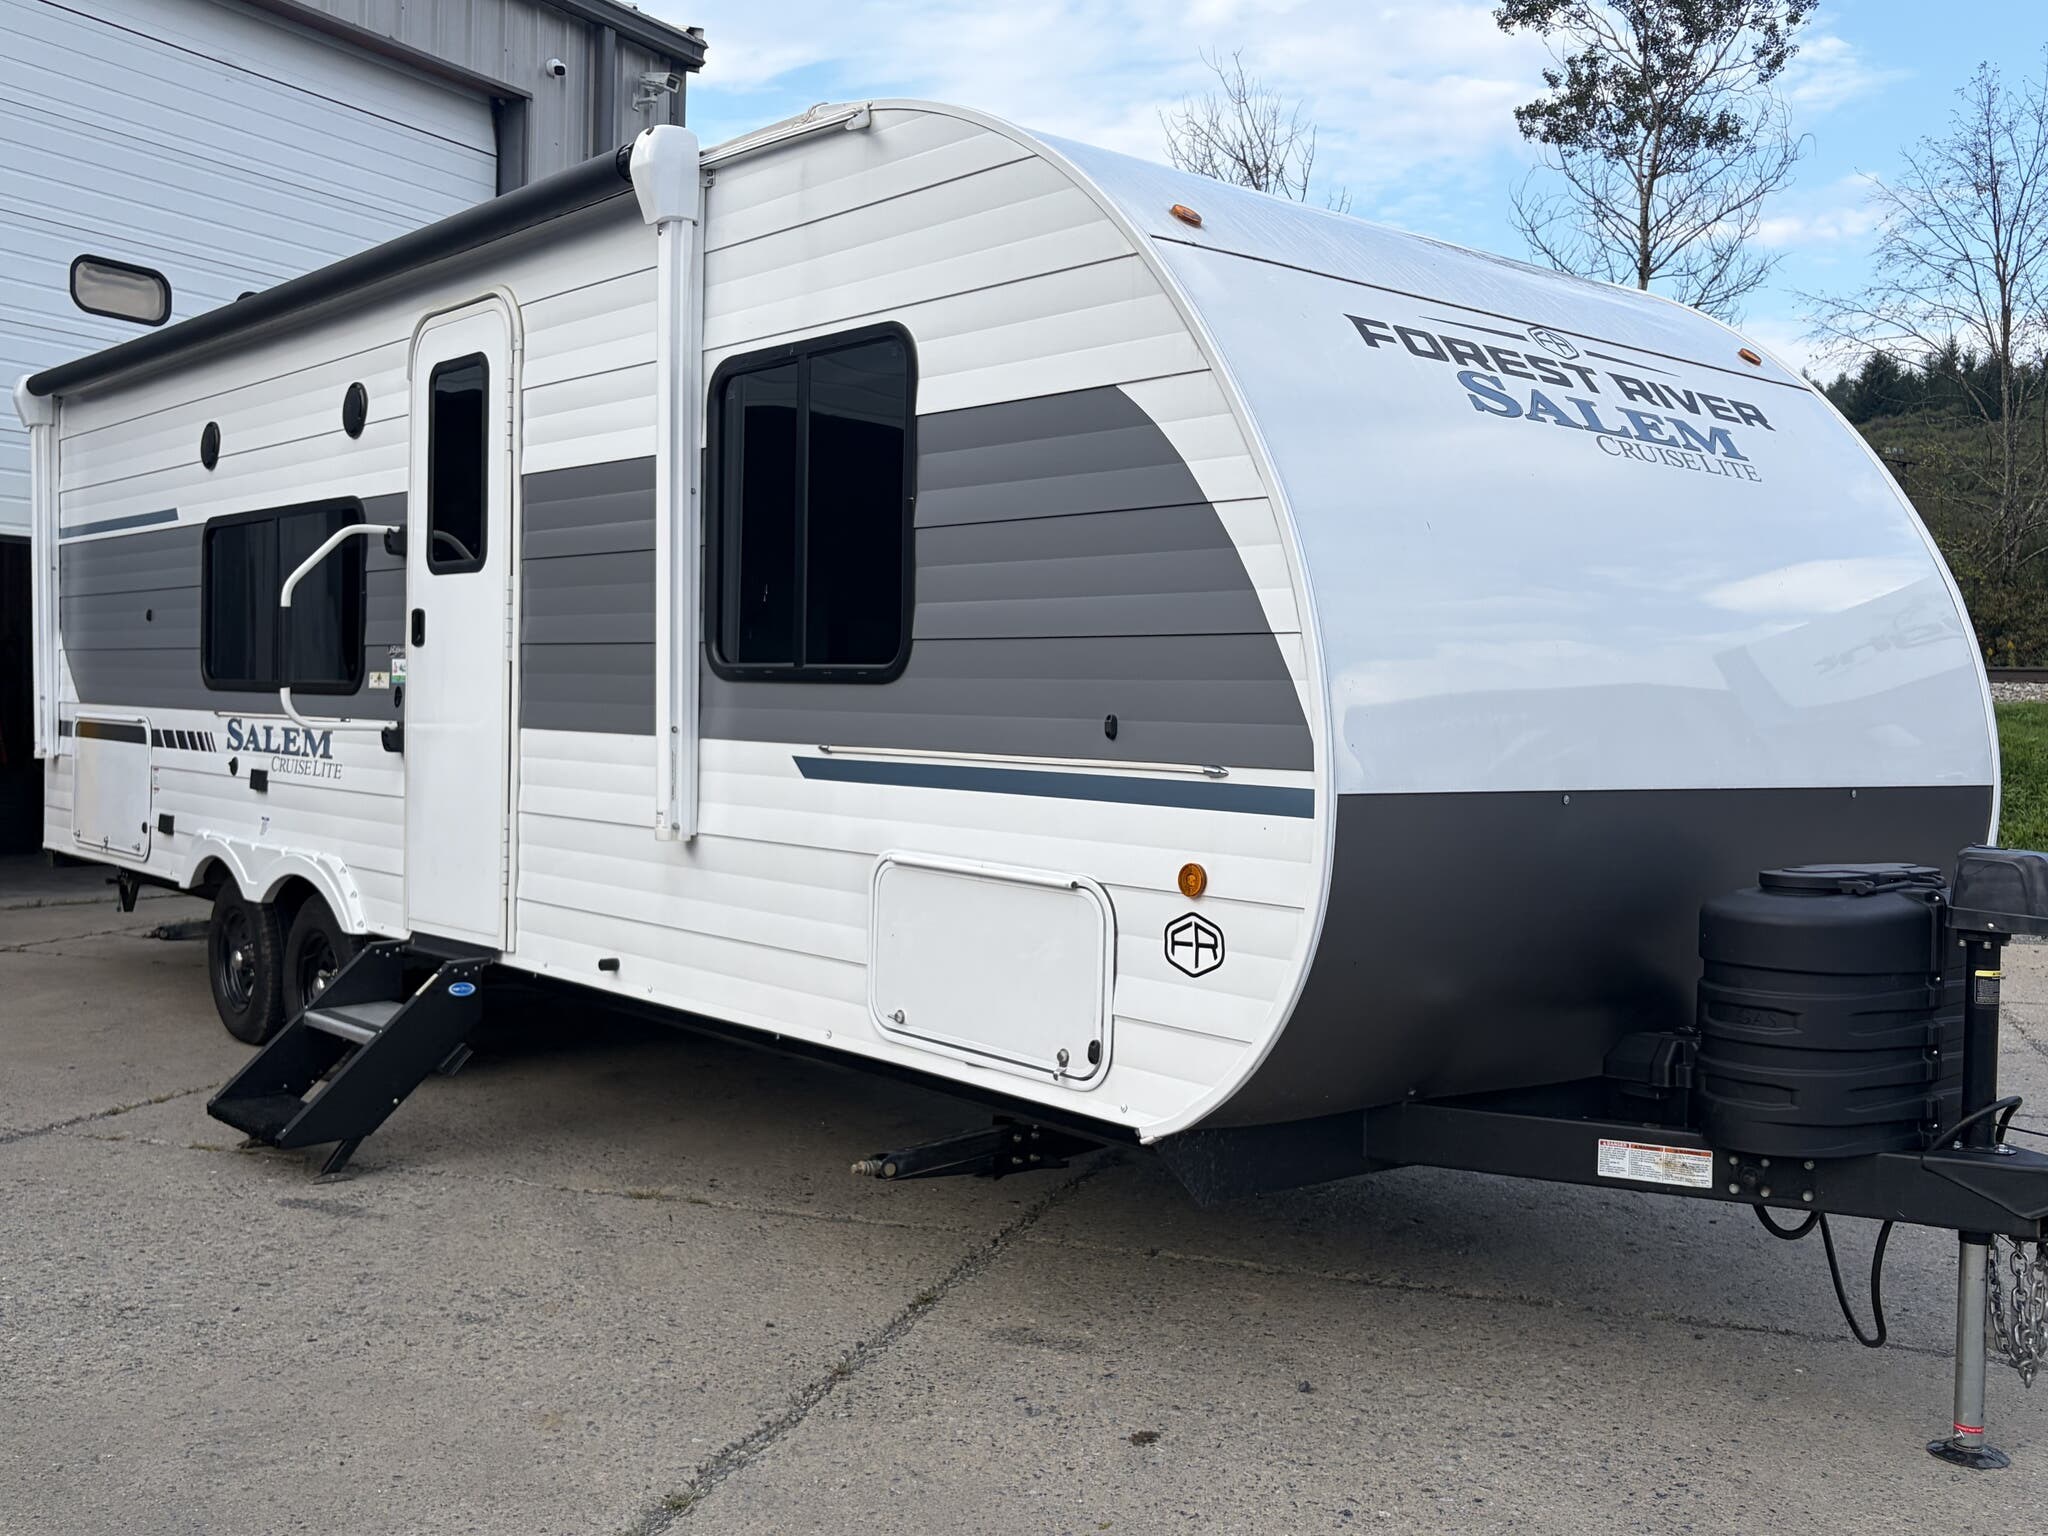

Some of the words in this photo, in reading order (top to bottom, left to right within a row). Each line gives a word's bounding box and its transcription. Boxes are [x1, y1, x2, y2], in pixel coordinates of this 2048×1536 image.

[1343, 313, 1601, 394] FOREST
[1604, 372, 1777, 432] RIVER
[1456, 370, 1749, 462] SALEM
[226, 718, 333, 759] SALEM
